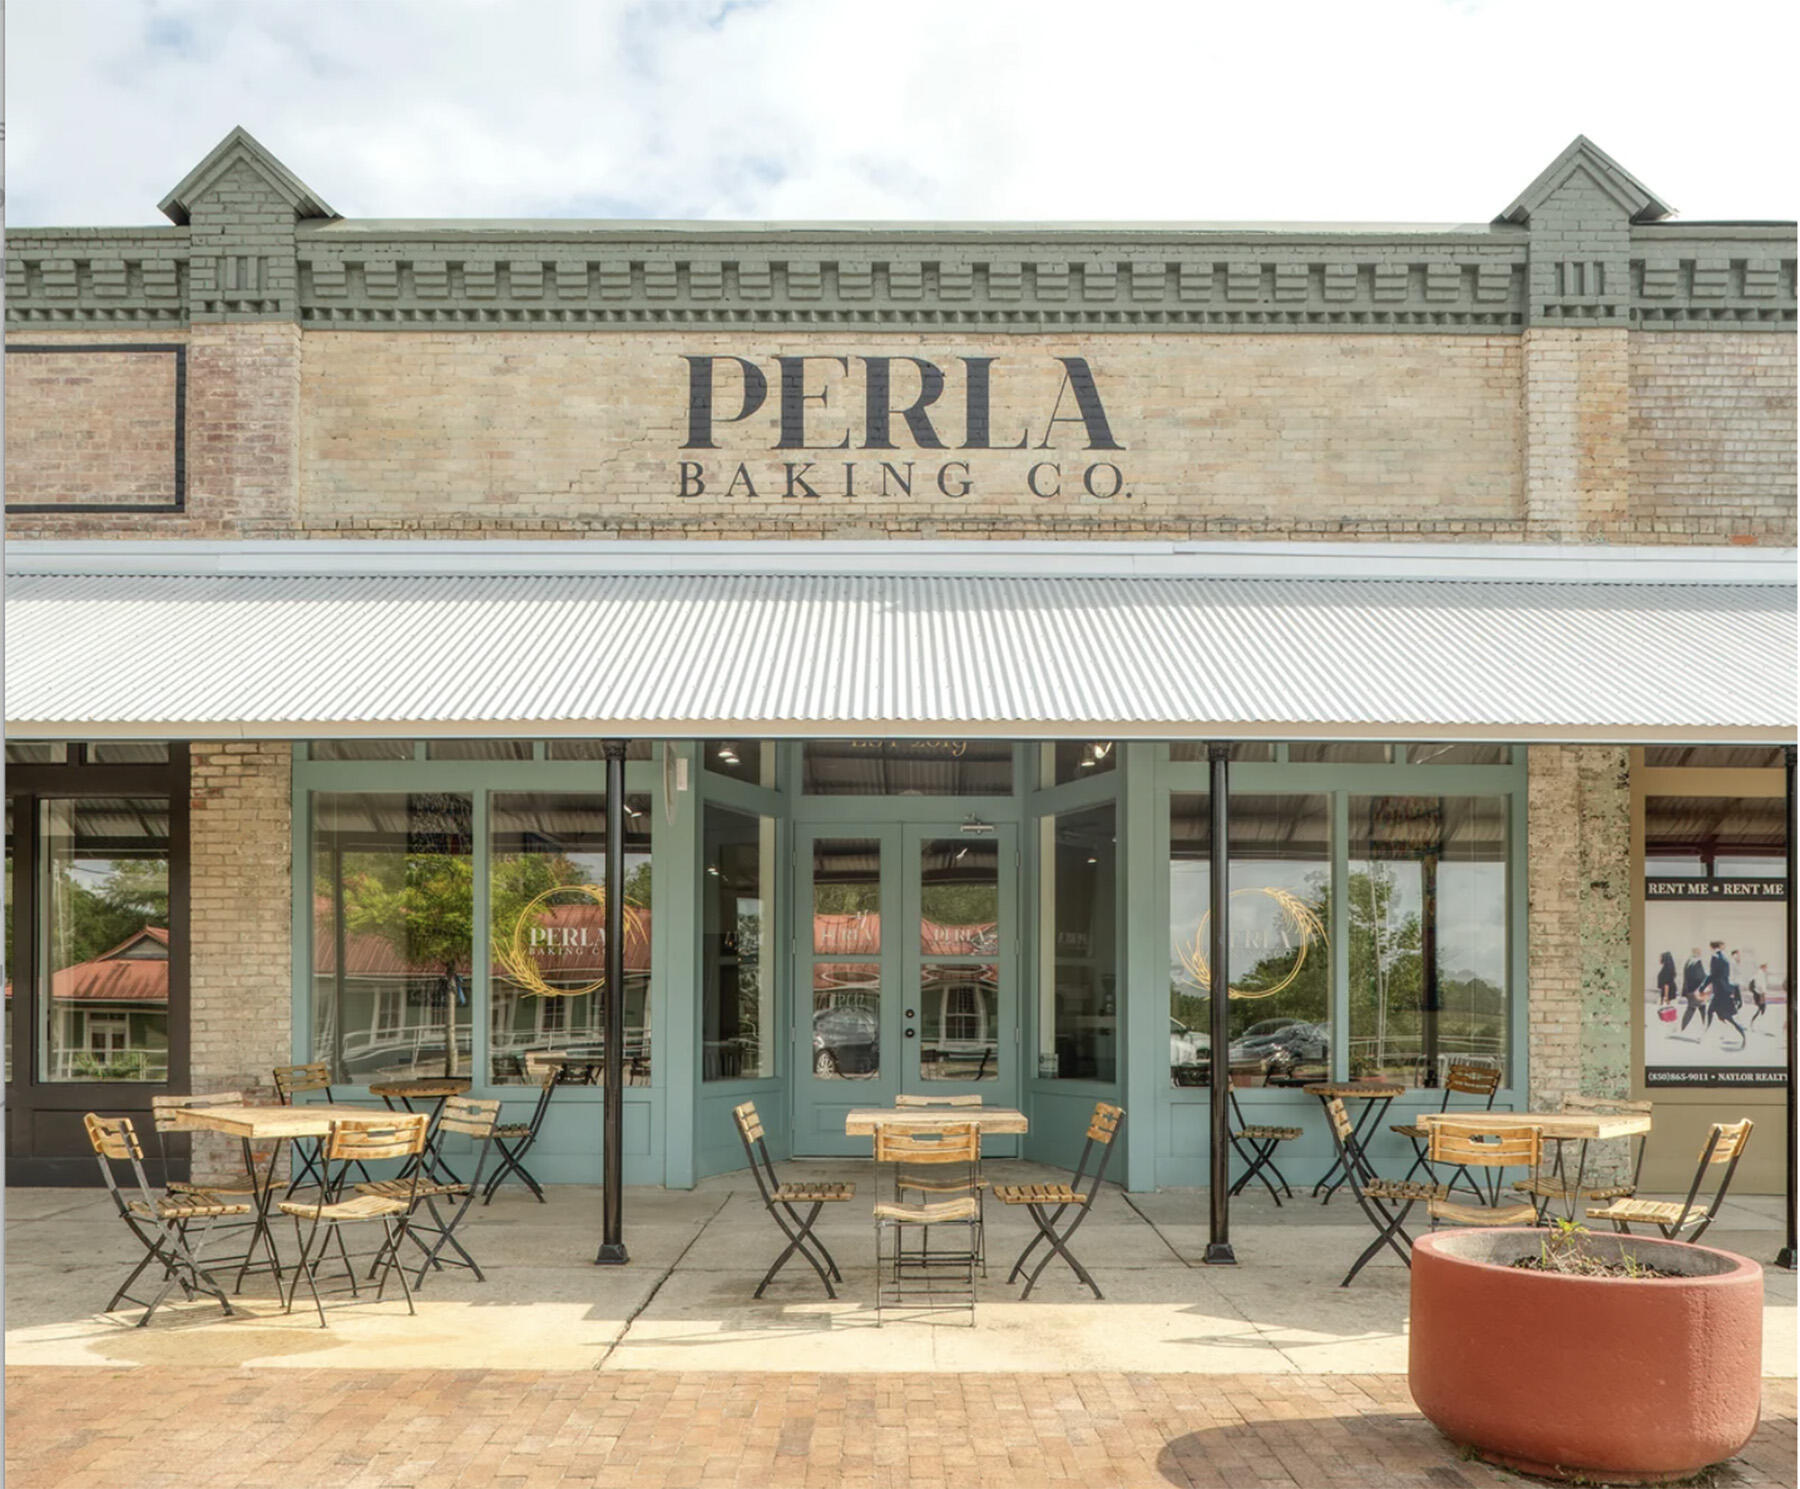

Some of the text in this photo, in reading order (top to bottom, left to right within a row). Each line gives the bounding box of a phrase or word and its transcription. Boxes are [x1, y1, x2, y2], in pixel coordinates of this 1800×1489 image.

[678, 355, 1127, 450] PERLA
[677, 461, 1132, 499] BAKING CO.
[1648, 883, 1784, 895] RENT ME RENT ME
[1718, 1072, 1754, 1081] NAYLOR
